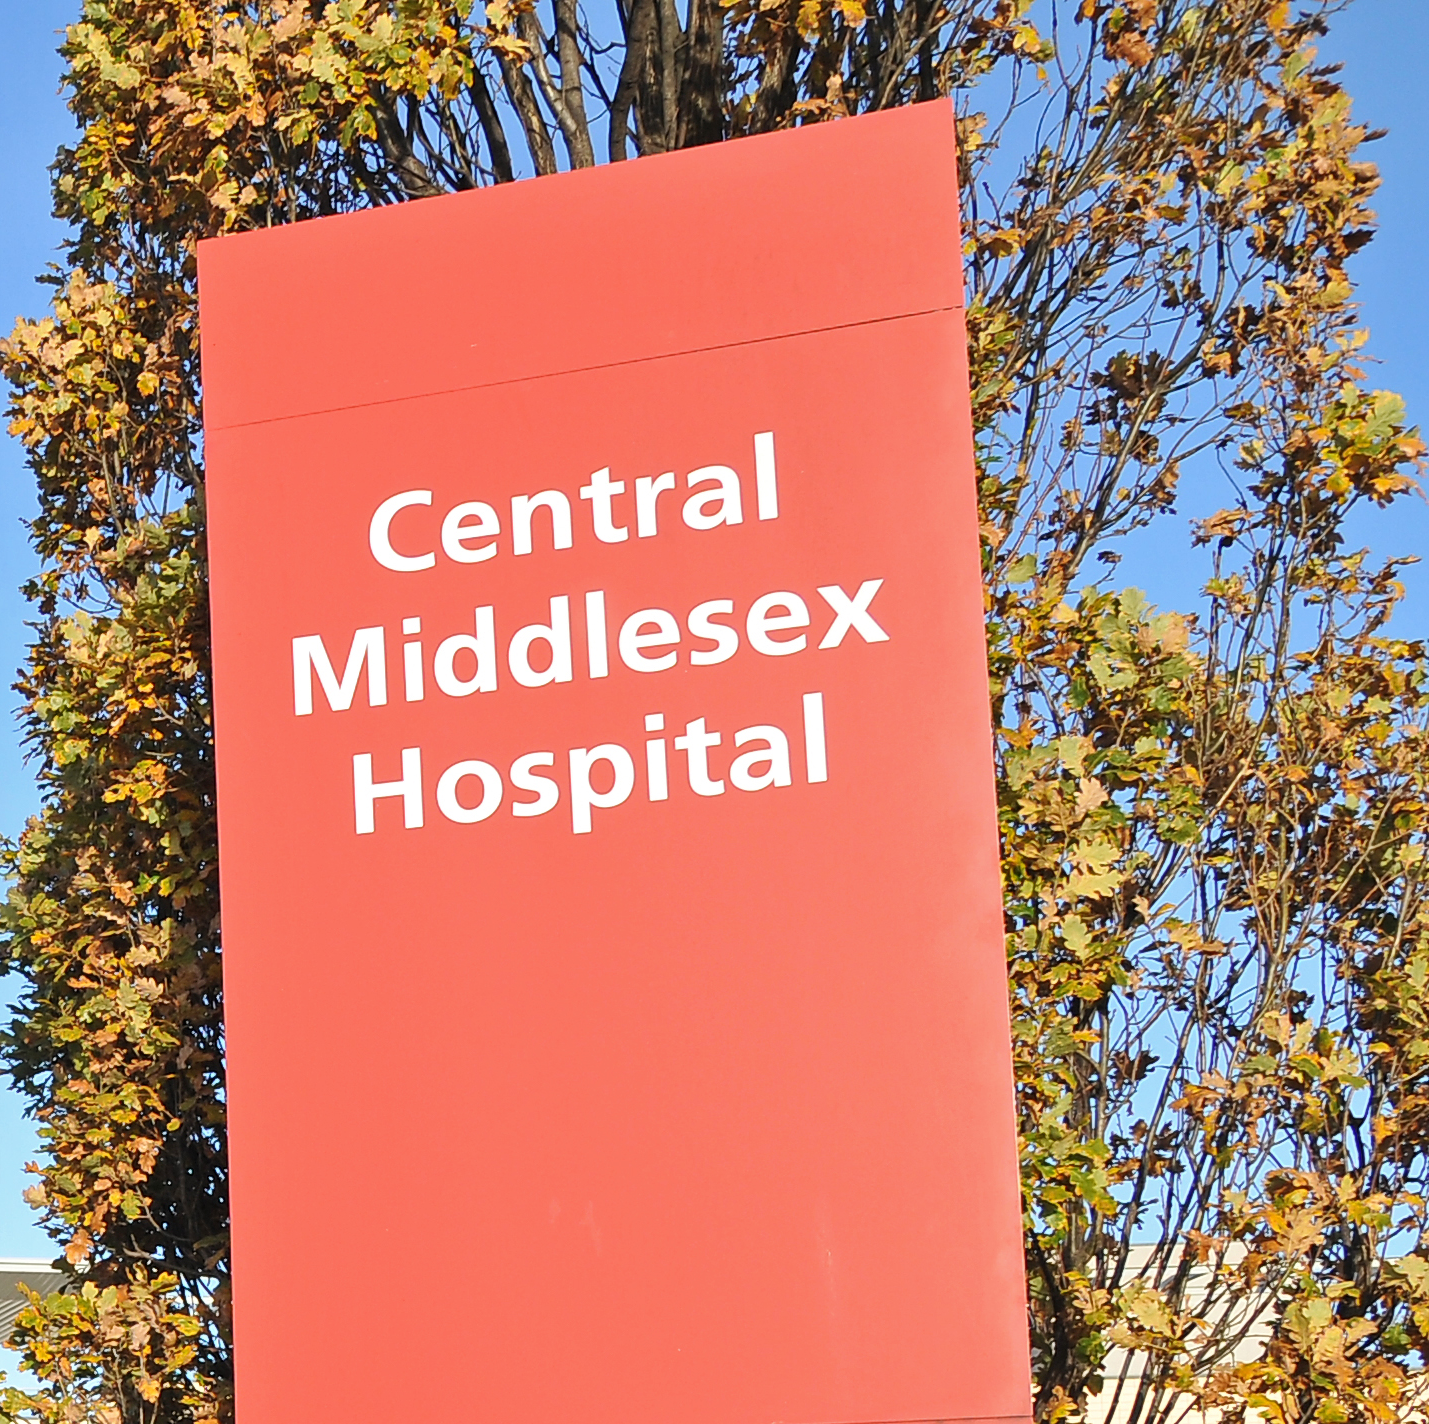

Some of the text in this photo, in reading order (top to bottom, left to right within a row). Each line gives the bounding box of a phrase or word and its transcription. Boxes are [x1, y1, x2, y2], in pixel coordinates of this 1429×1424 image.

[368, 430, 780, 573] Central
[290, 577, 890, 717] Middlesex
[352, 691, 829, 835] Hospital
